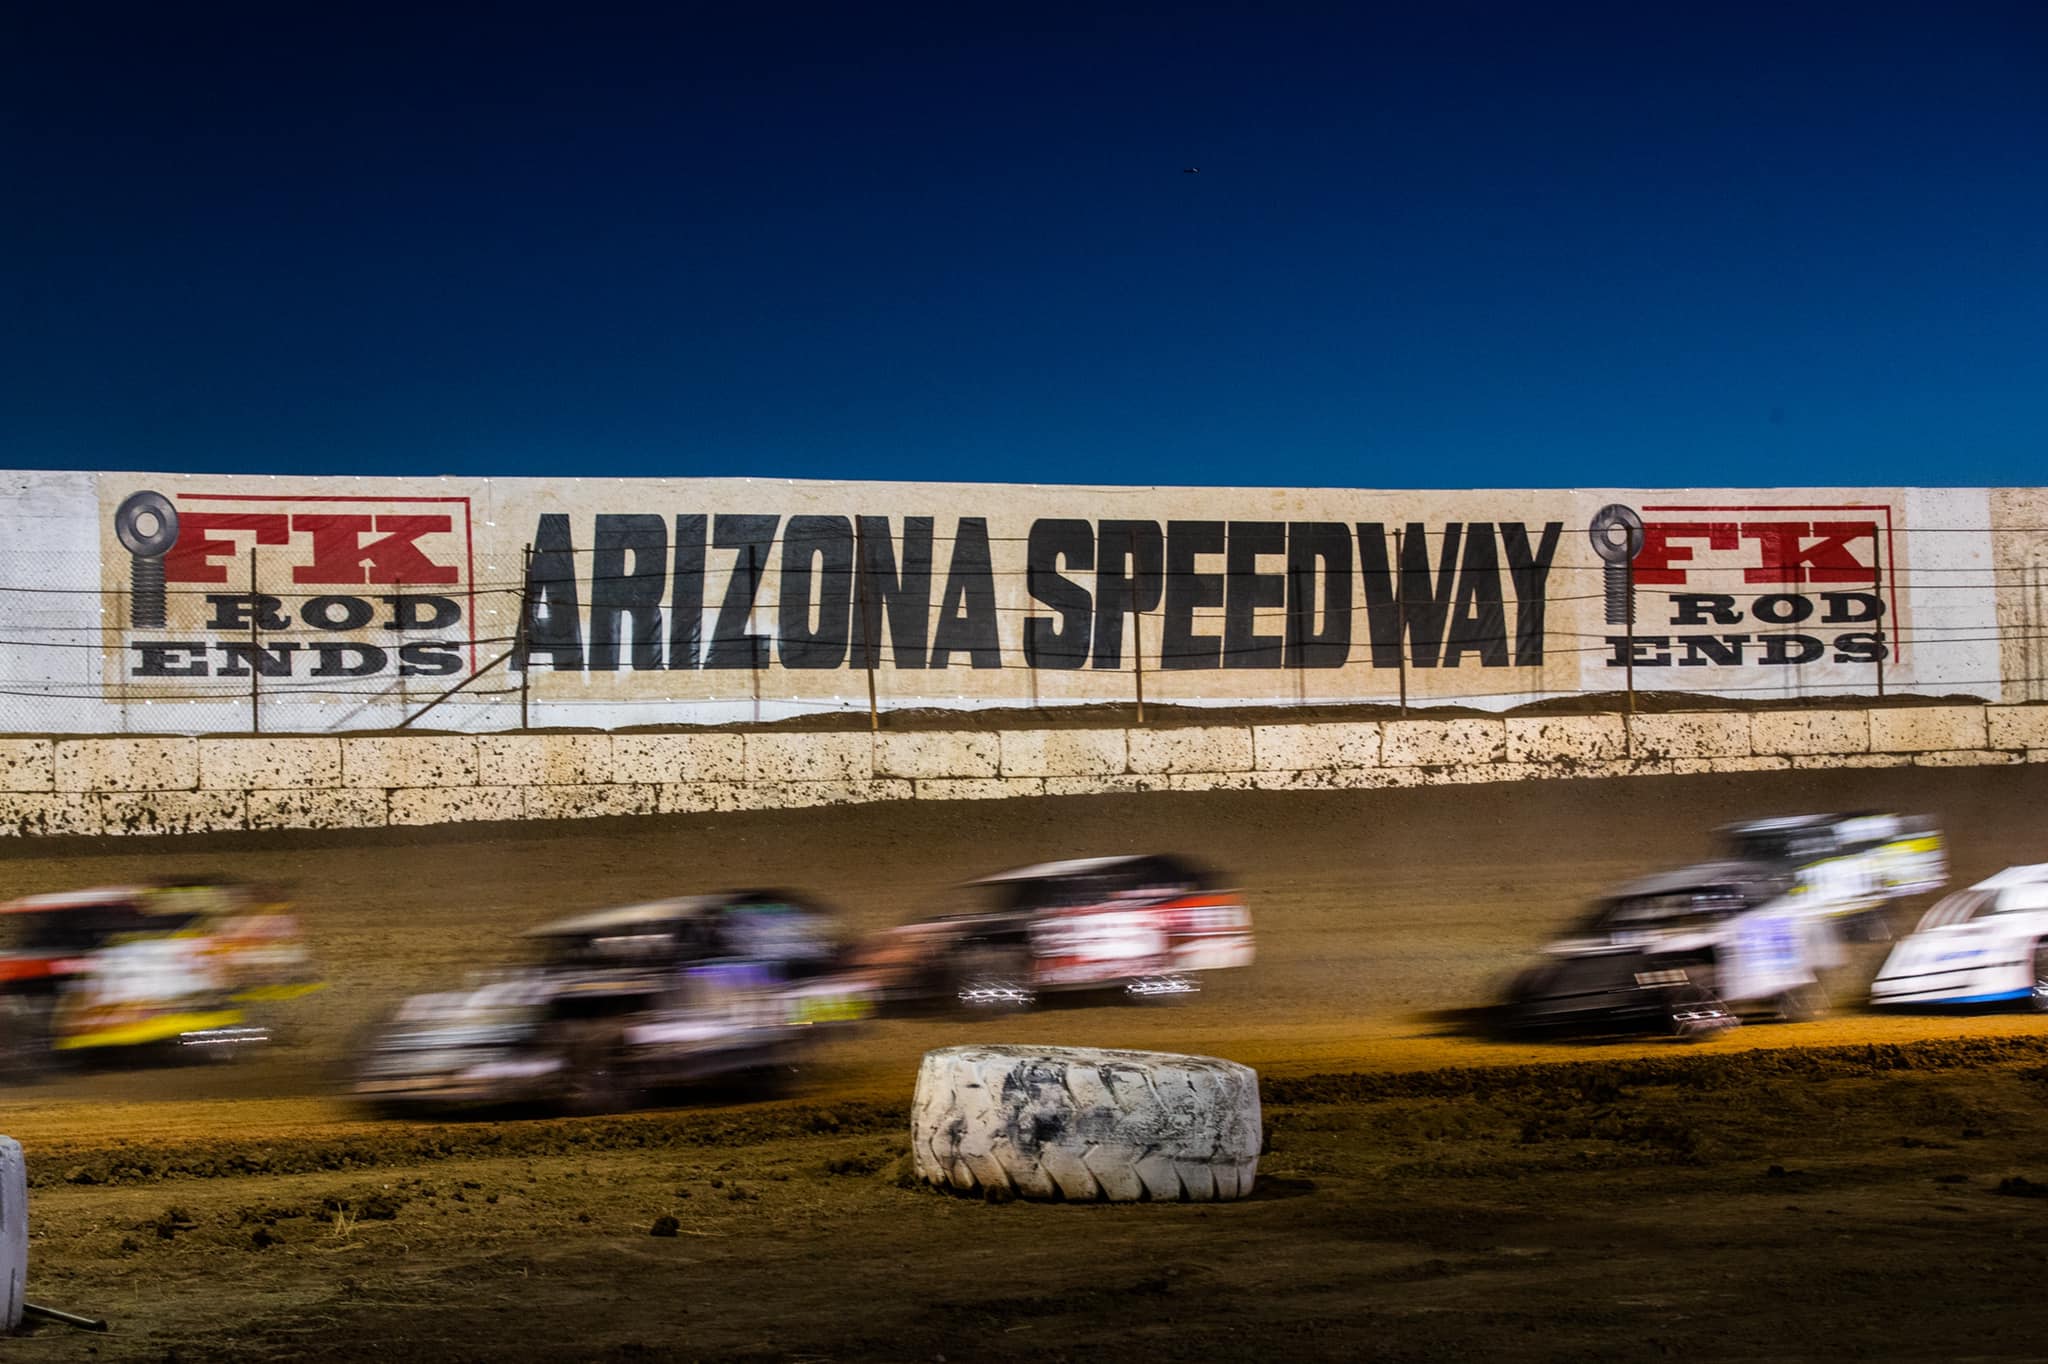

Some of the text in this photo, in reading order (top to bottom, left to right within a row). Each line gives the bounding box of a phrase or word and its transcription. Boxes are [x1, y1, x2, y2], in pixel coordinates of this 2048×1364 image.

[164, 513, 459, 584] FK
[1633, 521, 1878, 585] FK
[509, 513, 1564, 671] ARIZONA SPEEDWAY
[1669, 592, 1887, 626] ROD
[206, 594, 461, 630] ROD
[131, 641, 463, 677] ENDS
[1605, 633, 1888, 666] ENDS
